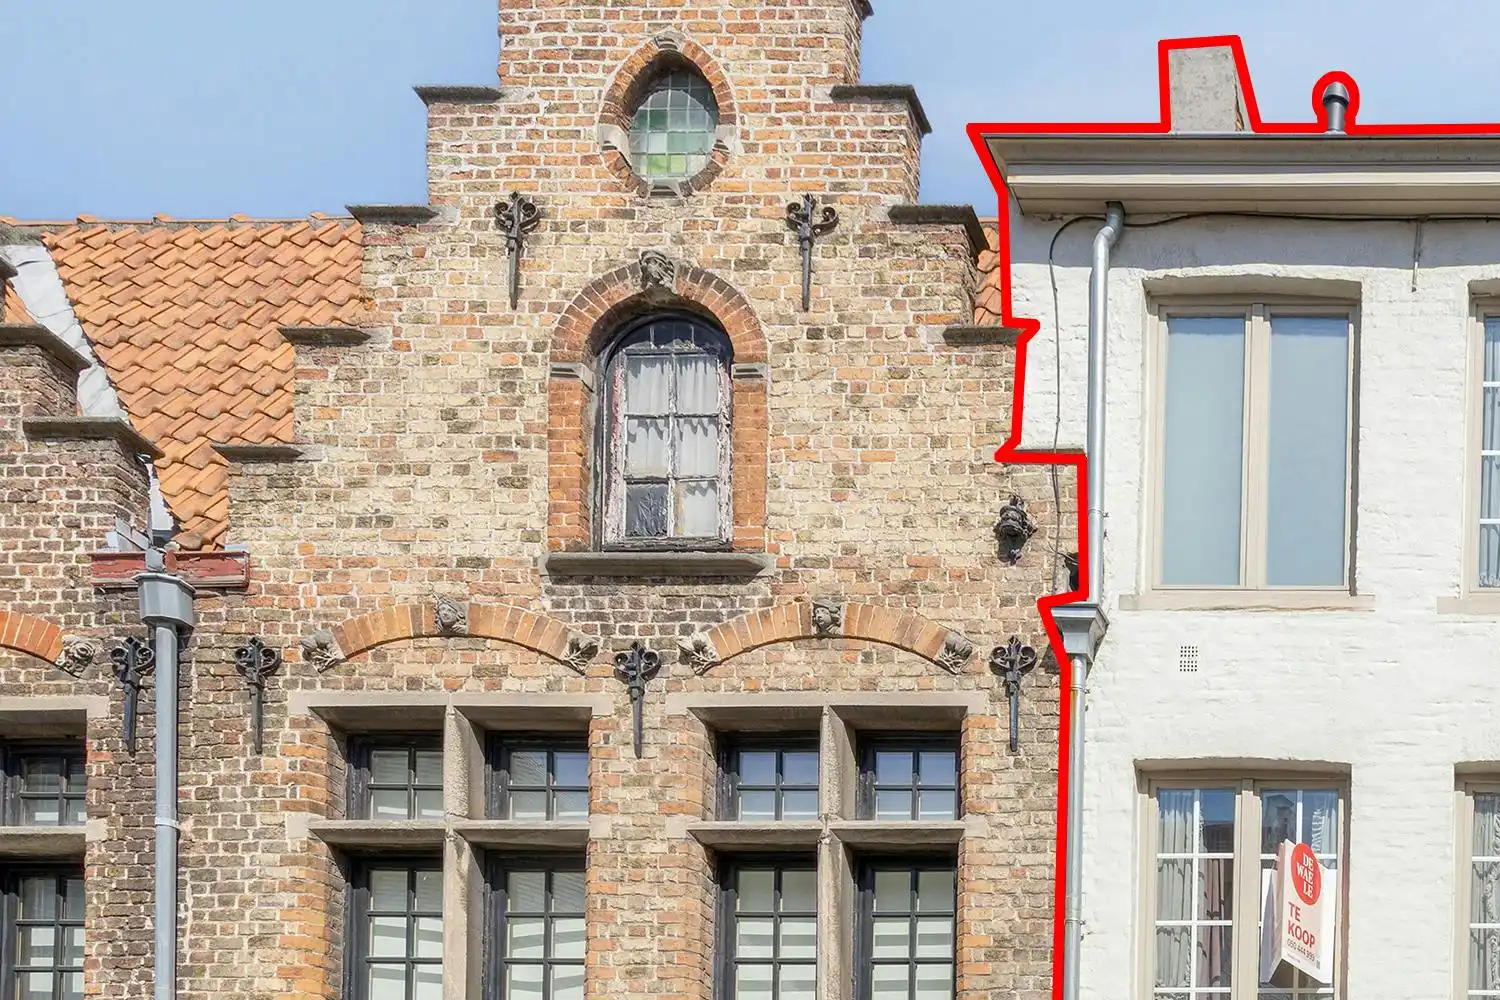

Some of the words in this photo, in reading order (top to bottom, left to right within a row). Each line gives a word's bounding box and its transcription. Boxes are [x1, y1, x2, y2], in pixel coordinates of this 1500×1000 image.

[1303, 852, 1314, 871] DE
[1296, 862, 1314, 885] WAE
[1303, 881, 1314, 899] LE
[1288, 901, 1301, 923] TE
[1287, 919, 1316, 949] KOOP
